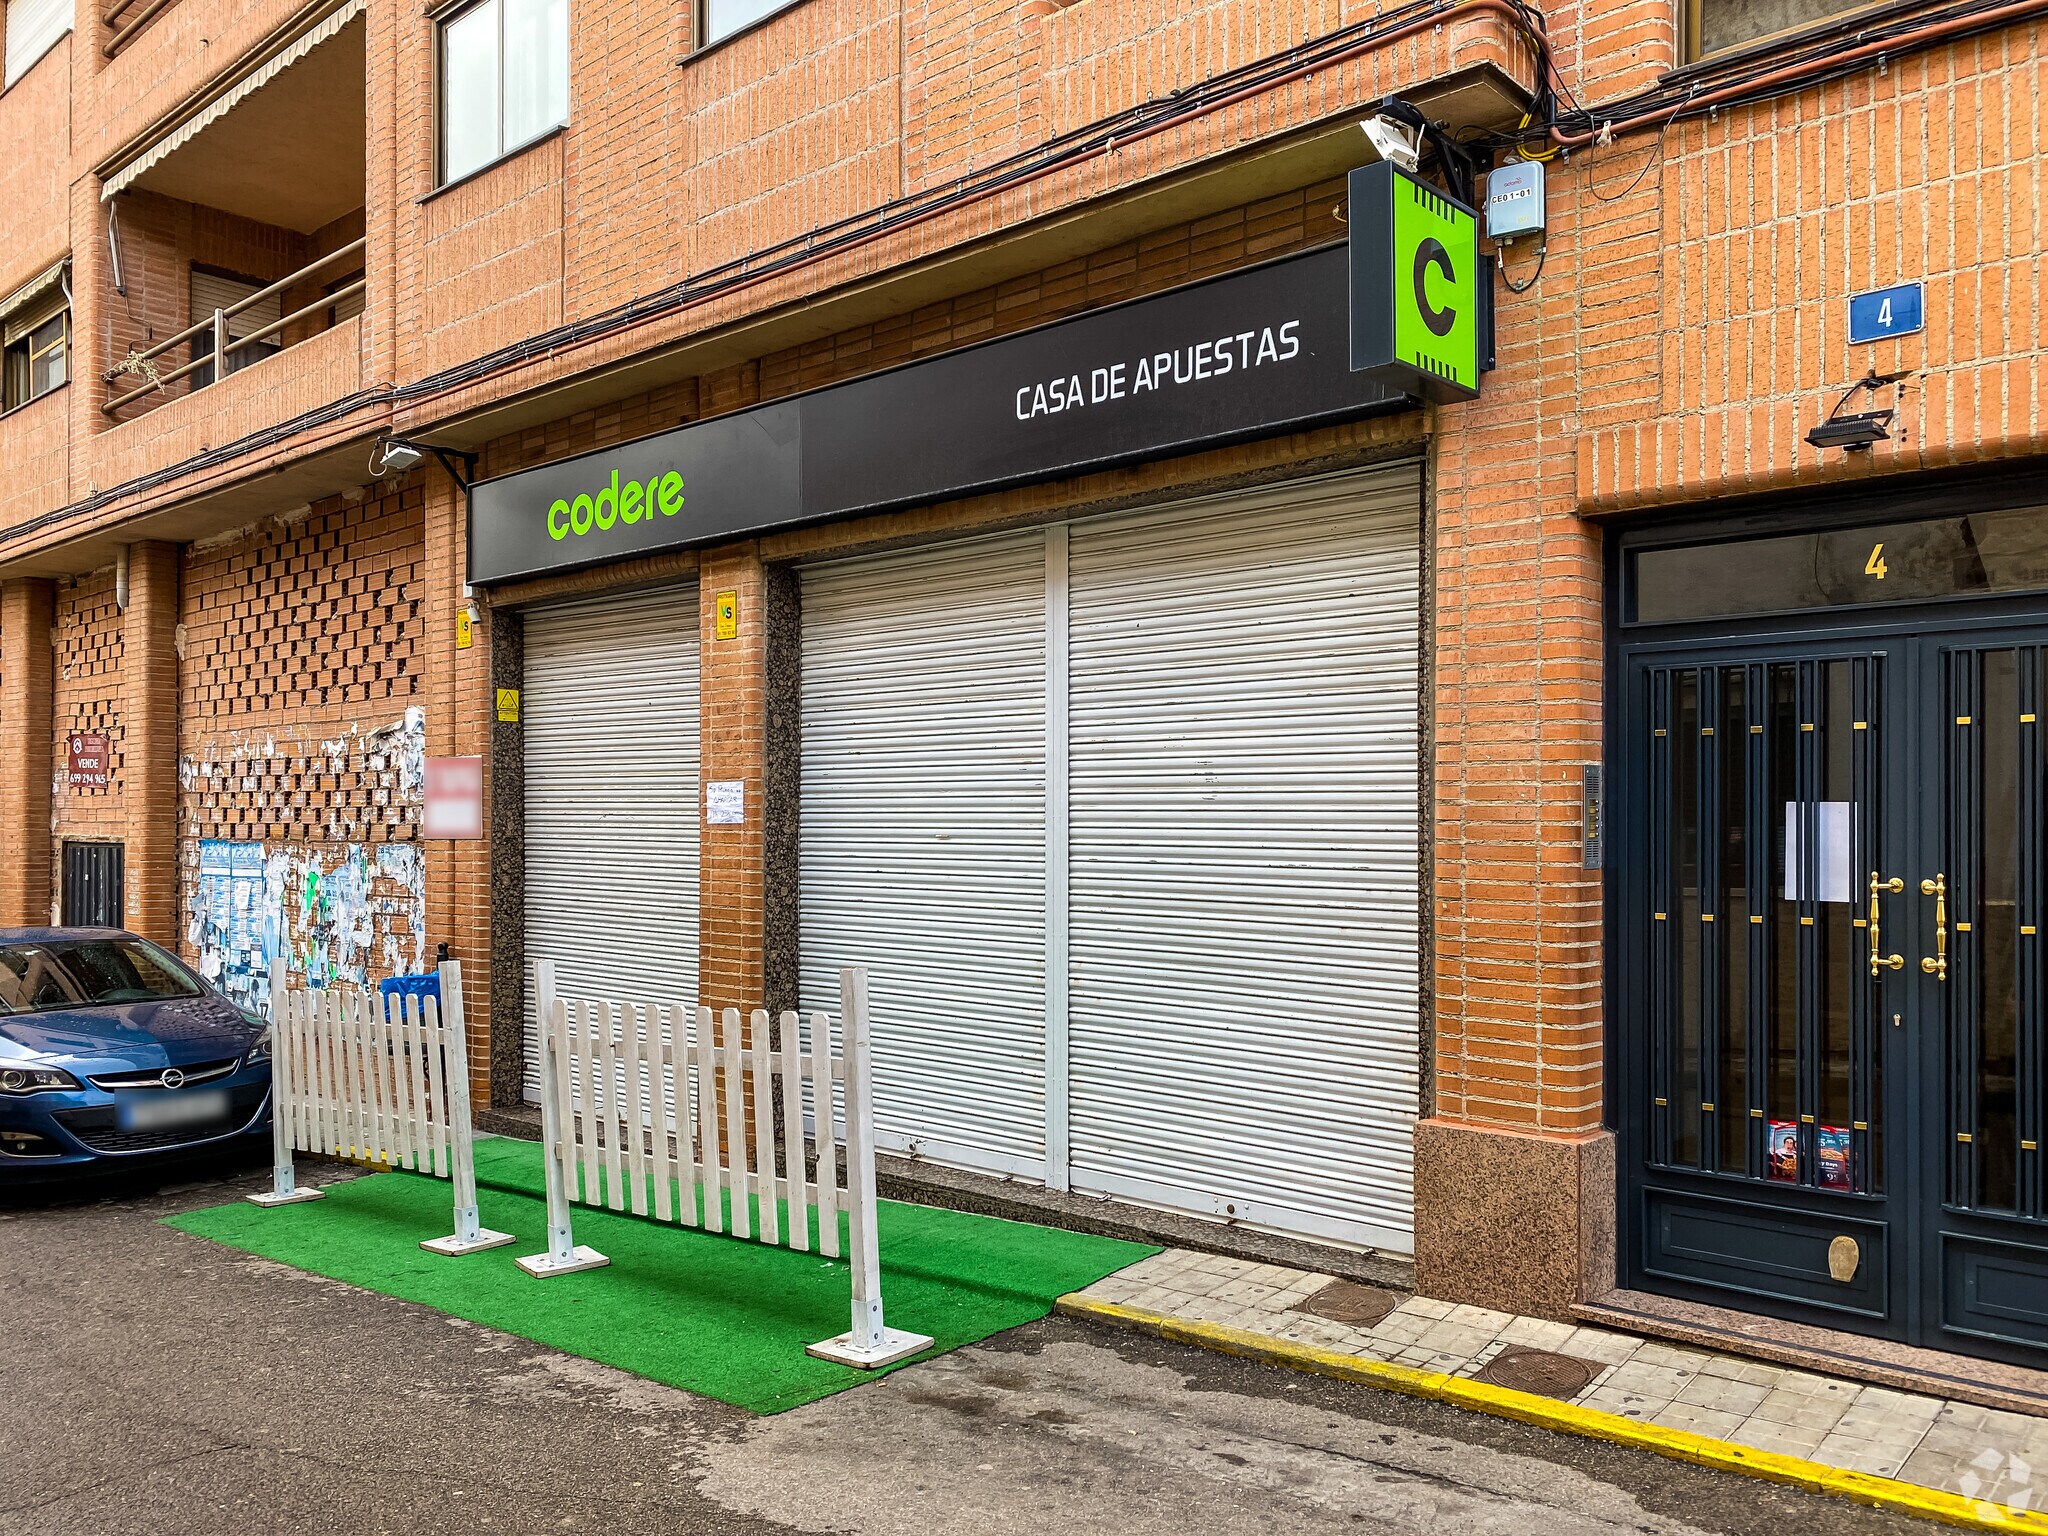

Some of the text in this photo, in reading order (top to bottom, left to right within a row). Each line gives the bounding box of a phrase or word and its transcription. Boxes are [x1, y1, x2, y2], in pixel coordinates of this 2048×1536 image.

[1413, 237, 1456, 337] C
[1878, 297, 1893, 328] 4
[1016, 319, 1300, 420] CASA DE APUESTAS
[547, 468, 685, 541] codere
[1865, 543, 1888, 580] 4
[70, 773, 81, 783] 699
[82, 774, 93, 784] 294
[77, 758, 99, 769] VENDE
